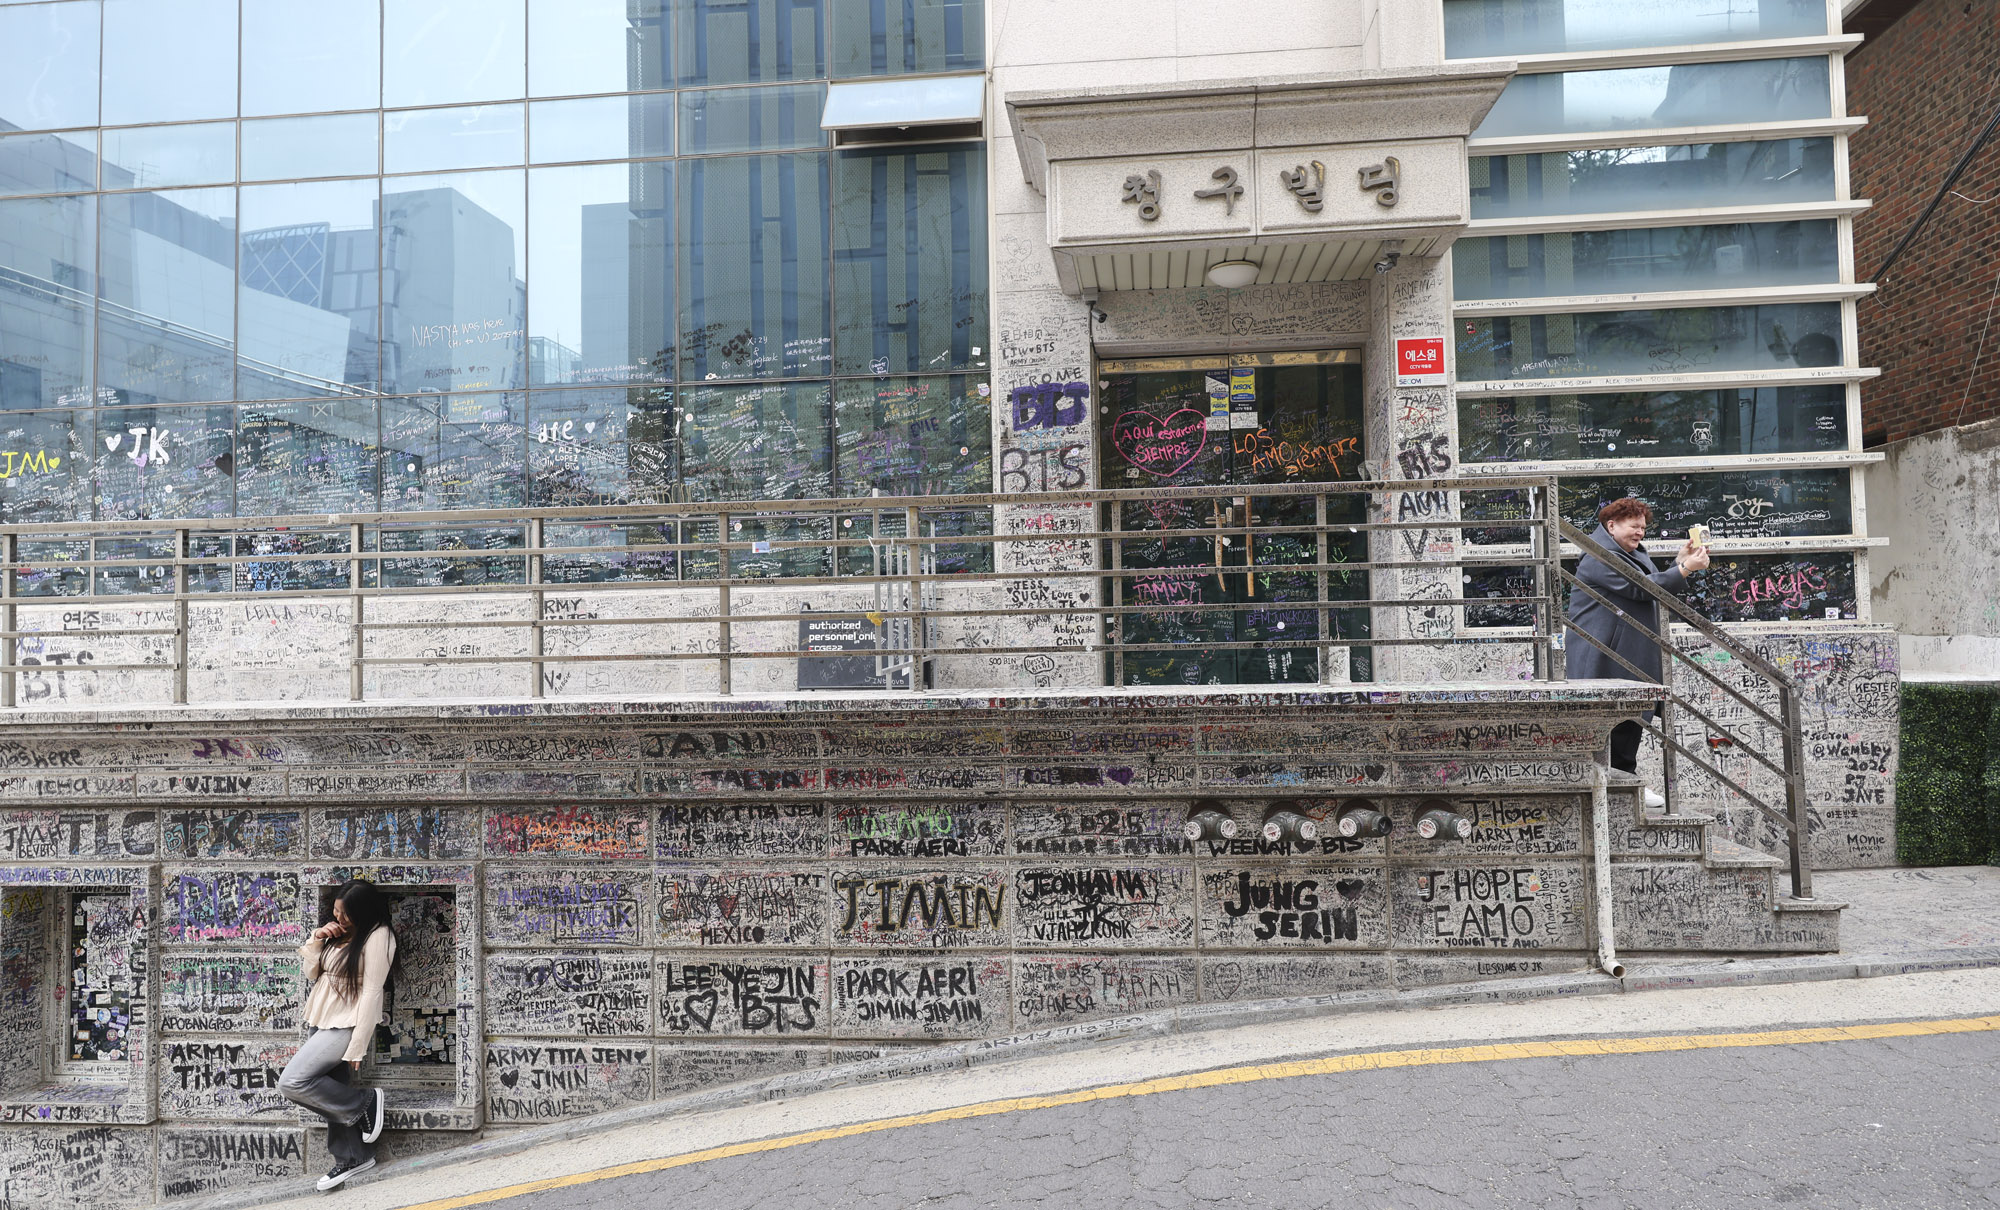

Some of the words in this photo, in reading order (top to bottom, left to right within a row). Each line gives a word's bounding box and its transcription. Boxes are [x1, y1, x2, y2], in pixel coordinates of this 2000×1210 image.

[1311, 284, 1348, 297] HERE
[412, 323, 458, 348] NASTYA
[461, 322, 480, 334] was
[483, 318, 504, 328] here
[1036, 342, 1055, 353] BTS
[1405, 349, 1436, 361] 에스원
[1008, 367, 1083, 389] JEROME
[311, 403, 336, 417] TXT
[482, 410, 509, 420] Jimin
[1399, 406, 1439, 425] TXT
[1158, 420, 1205, 440] estaremos
[128, 428, 170, 464] JK
[1234, 429, 1273, 454] LOS
[555, 454, 578, 462] LOPEZ
[1135, 442, 1190, 463] SIEMPRE
[1252, 442, 1293, 474] AMO
[1286, 436, 1360, 477] siempre
[0, 450, 48, 478] JM
[1001, 444, 1086, 492] BTS
[1398, 450, 1451, 479] BTS
[1433, 480, 1447, 488] BTS
[1650, 482, 1692, 496] ARMY
[992, 494, 1011, 502] BACK
[1722, 494, 1773, 517] Joy
[704, 502, 758, 511] JUNGKOOK
[1402, 530, 1428, 561] V
[1013, 580, 1043, 590] JESS
[1133, 584, 1195, 600] TAMMY
[1732, 566, 1827, 603] GRACIAS
[1012, 591, 1048, 602] SUGA
[1052, 591, 1073, 600] LOVE
[545, 600, 582, 614] RMY
[809, 621, 861, 630] authorized
[1065, 614, 1094, 622] 4ever
[809, 632, 857, 642] personnel
[1053, 625, 1074, 635] Abby
[22, 650, 98, 700] BTS
[1742, 675, 1769, 688] BTS
[1856, 682, 1897, 693] KESTER
[1857, 692, 1889, 703] 2025
[1827, 732, 1849, 741] You
[191, 739, 242, 759] JK
[1496, 763, 1559, 777] MEXICO
[1848, 758, 1887, 773] 2026
[1147, 767, 1186, 783] PERU
[201, 778, 238, 793] JIN
[660, 805, 722, 825] ARMY
[784, 804, 823, 818] JEN
[1826, 810, 1858, 819] 아포방포
[1519, 825, 1545, 840] ME
[1614, 829, 1701, 850] YEONJUN
[851, 839, 905, 857] PARK
[913, 838, 966, 857] AERI
[1208, 840, 1290, 856] WEENAH
[1321, 838, 1364, 853] BTS
[72, 868, 114, 884] ARMY
[793, 874, 822, 887] TXT
[1421, 869, 1534, 902] J-HOPE
[1224, 872, 1319, 916] JUNG
[837, 881, 1005, 934] JIMIN
[1073, 905, 1127, 930] JK
[1460, 903, 1533, 937] AMO
[701, 927, 764, 945] MEXICO
[932, 934, 968, 948] DIANA
[1444, 937, 1485, 948] YOONGI
[1490, 938, 1507, 948] TE
[1754, 928, 1827, 945] ARGENTINA
[557, 960, 596, 975] JIMIN
[1532, 963, 1544, 971] JK
[667, 963, 713, 996] LEE
[847, 967, 910, 998] PARK
[916, 962, 976, 998] AERI
[742, 994, 821, 1033] BTS
[858, 1000, 917, 1021] JIMIN
[161, 1017, 232, 1031] APOBANGPO
[584, 1020, 644, 1035] TAEHYUNG
[486, 1049, 541, 1067] ARMY
[545, 1049, 586, 1064] TITA
[592, 1048, 631, 1064] JEN
[173, 1066, 226, 1089] Tita
[532, 1069, 588, 1089] JIMIN
[5, 1106, 36, 1120] JK
[491, 1098, 570, 1120] MONIQUE
[439, 1113, 473, 1128] BTS
[33, 1138, 66, 1150] AGGIE
